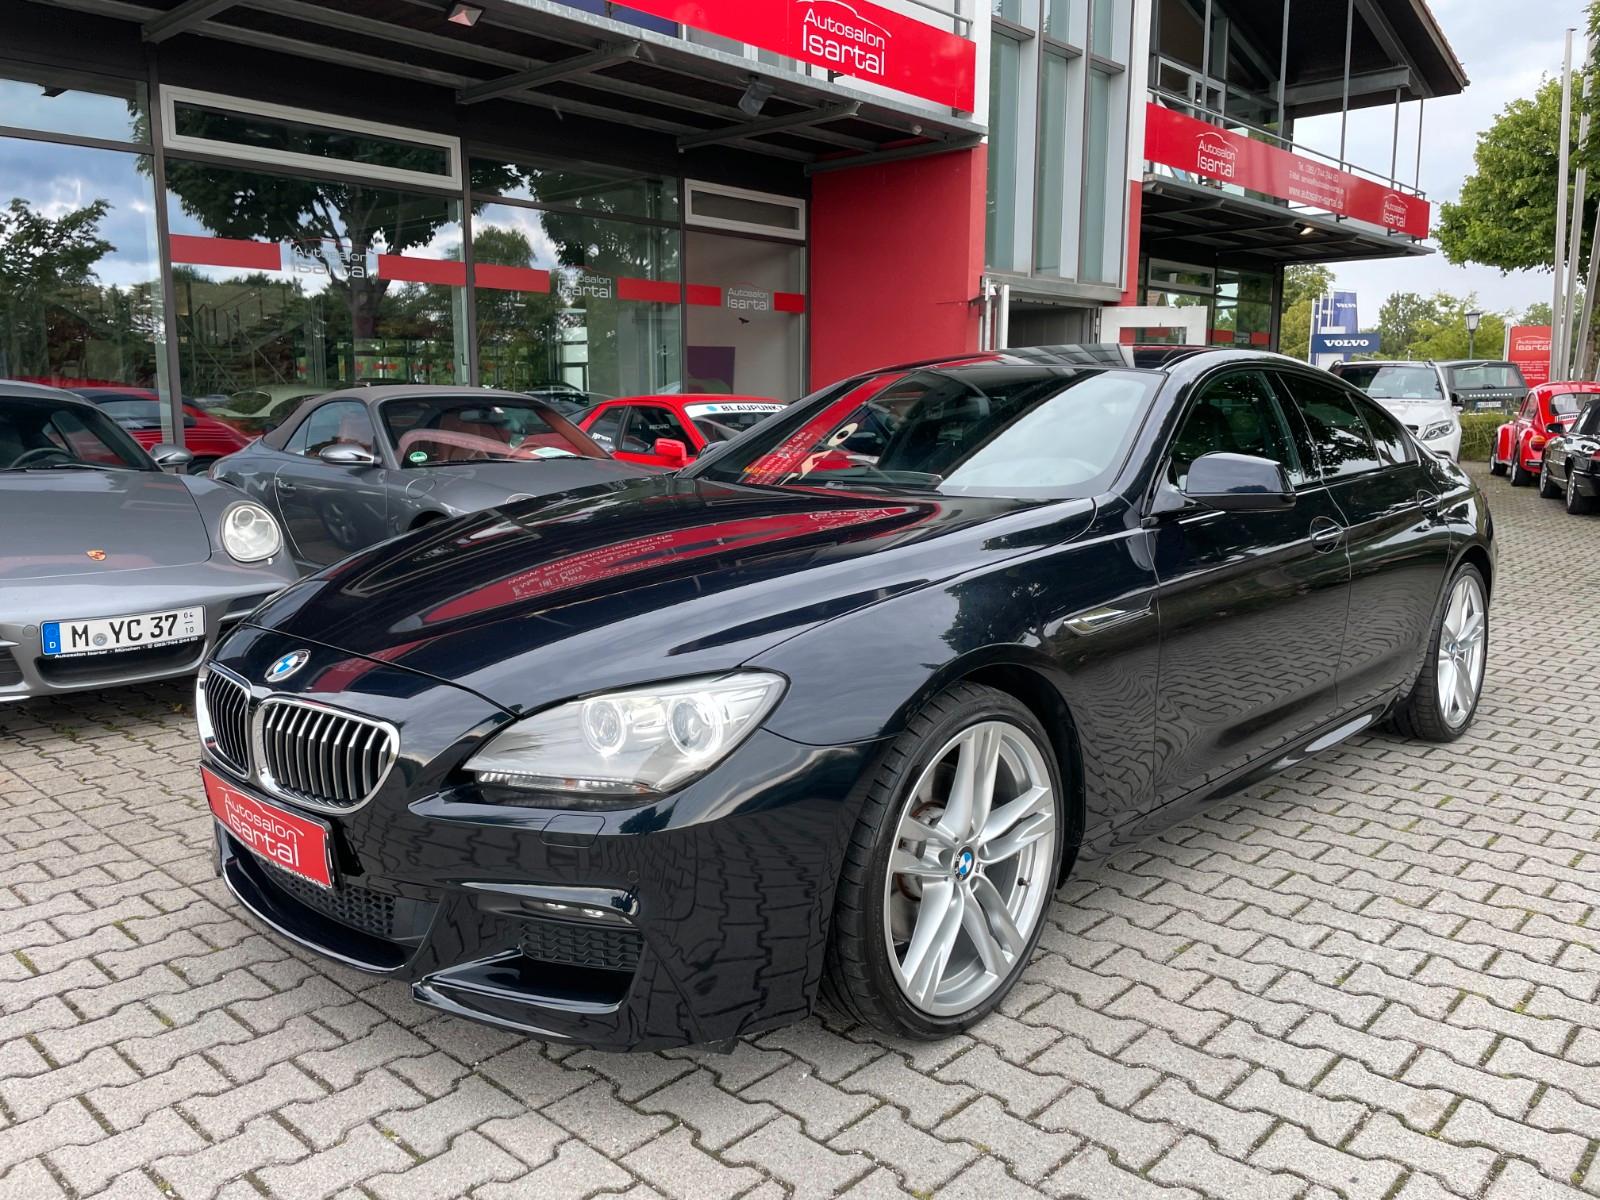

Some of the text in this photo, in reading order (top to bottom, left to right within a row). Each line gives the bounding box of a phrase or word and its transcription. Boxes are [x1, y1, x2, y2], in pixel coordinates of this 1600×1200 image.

[803, 8, 886, 50] Autosalon
[802, 24, 885, 76] Isartal
[1198, 139, 1236, 160] Autosalon
[1197, 150, 1235, 178] Isartal
[1383, 208, 1406, 228] Isartal
[727, 295, 769, 311] Isartal
[728, 287, 769, 299] Autosalon
[1323, 339, 1369, 347] VOLVO
[71, 613, 178, 648] M YC 37
[49, 641, 57, 649] D
[224, 793, 297, 844] Autosalon
[225, 804, 299, 867] Isartal
